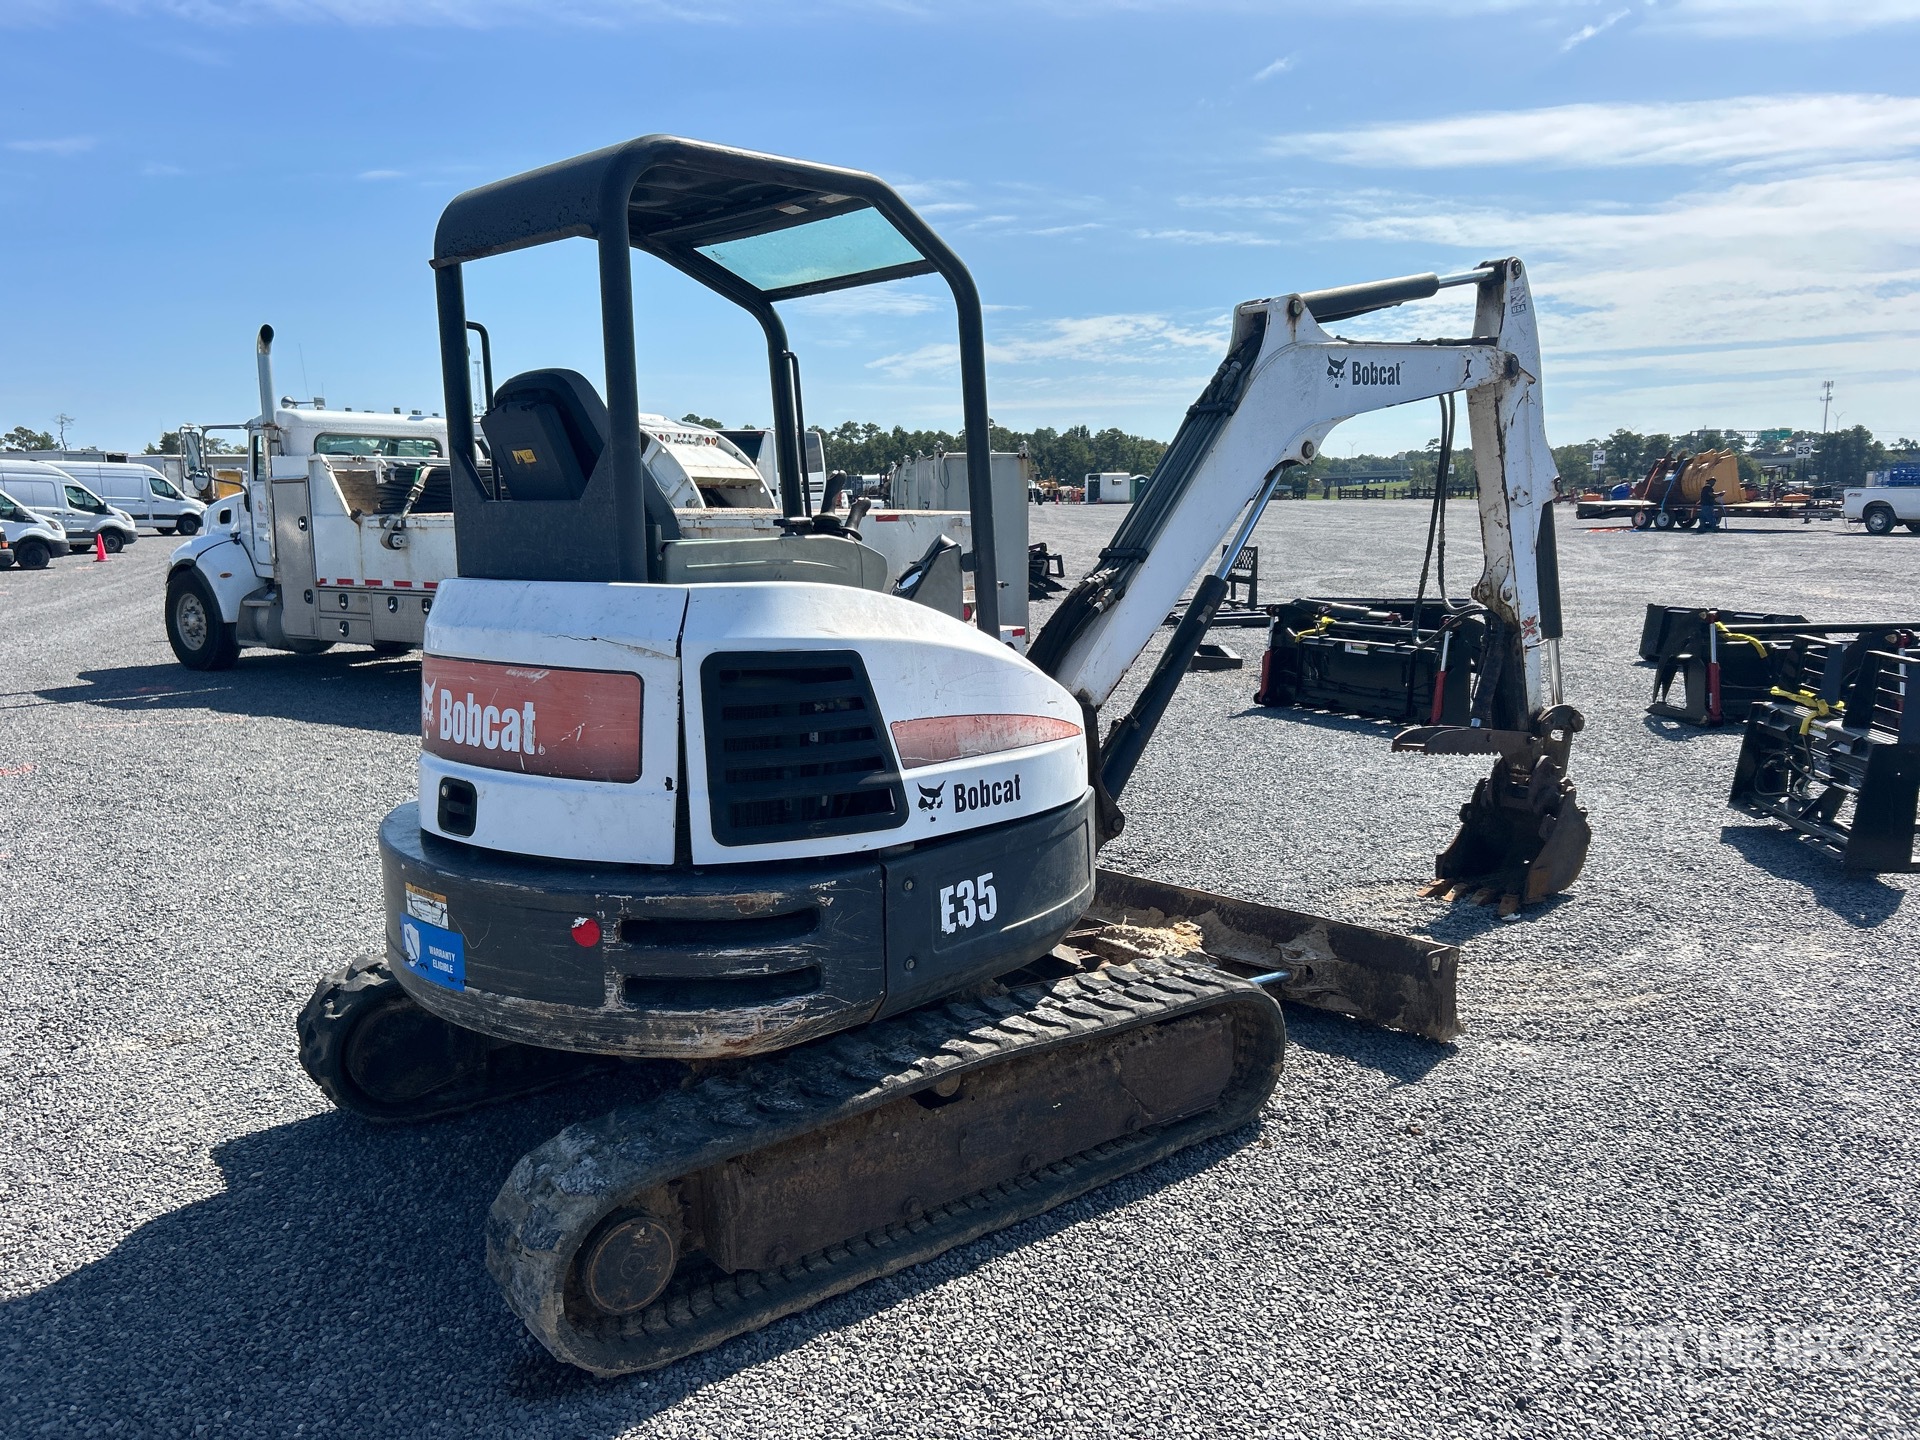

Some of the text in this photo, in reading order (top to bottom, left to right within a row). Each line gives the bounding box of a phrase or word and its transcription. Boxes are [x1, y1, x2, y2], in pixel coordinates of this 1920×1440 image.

[1352, 361, 1401, 386] Bobcat
[1797, 446, 1810, 455] 53
[440, 688, 536, 755] Bobcat
[953, 774, 1021, 814] Bobcat
[939, 871, 998, 935] E35
[428, 945, 456, 963] WARRANTY
[432, 958, 454, 974] ELIGIBLE
